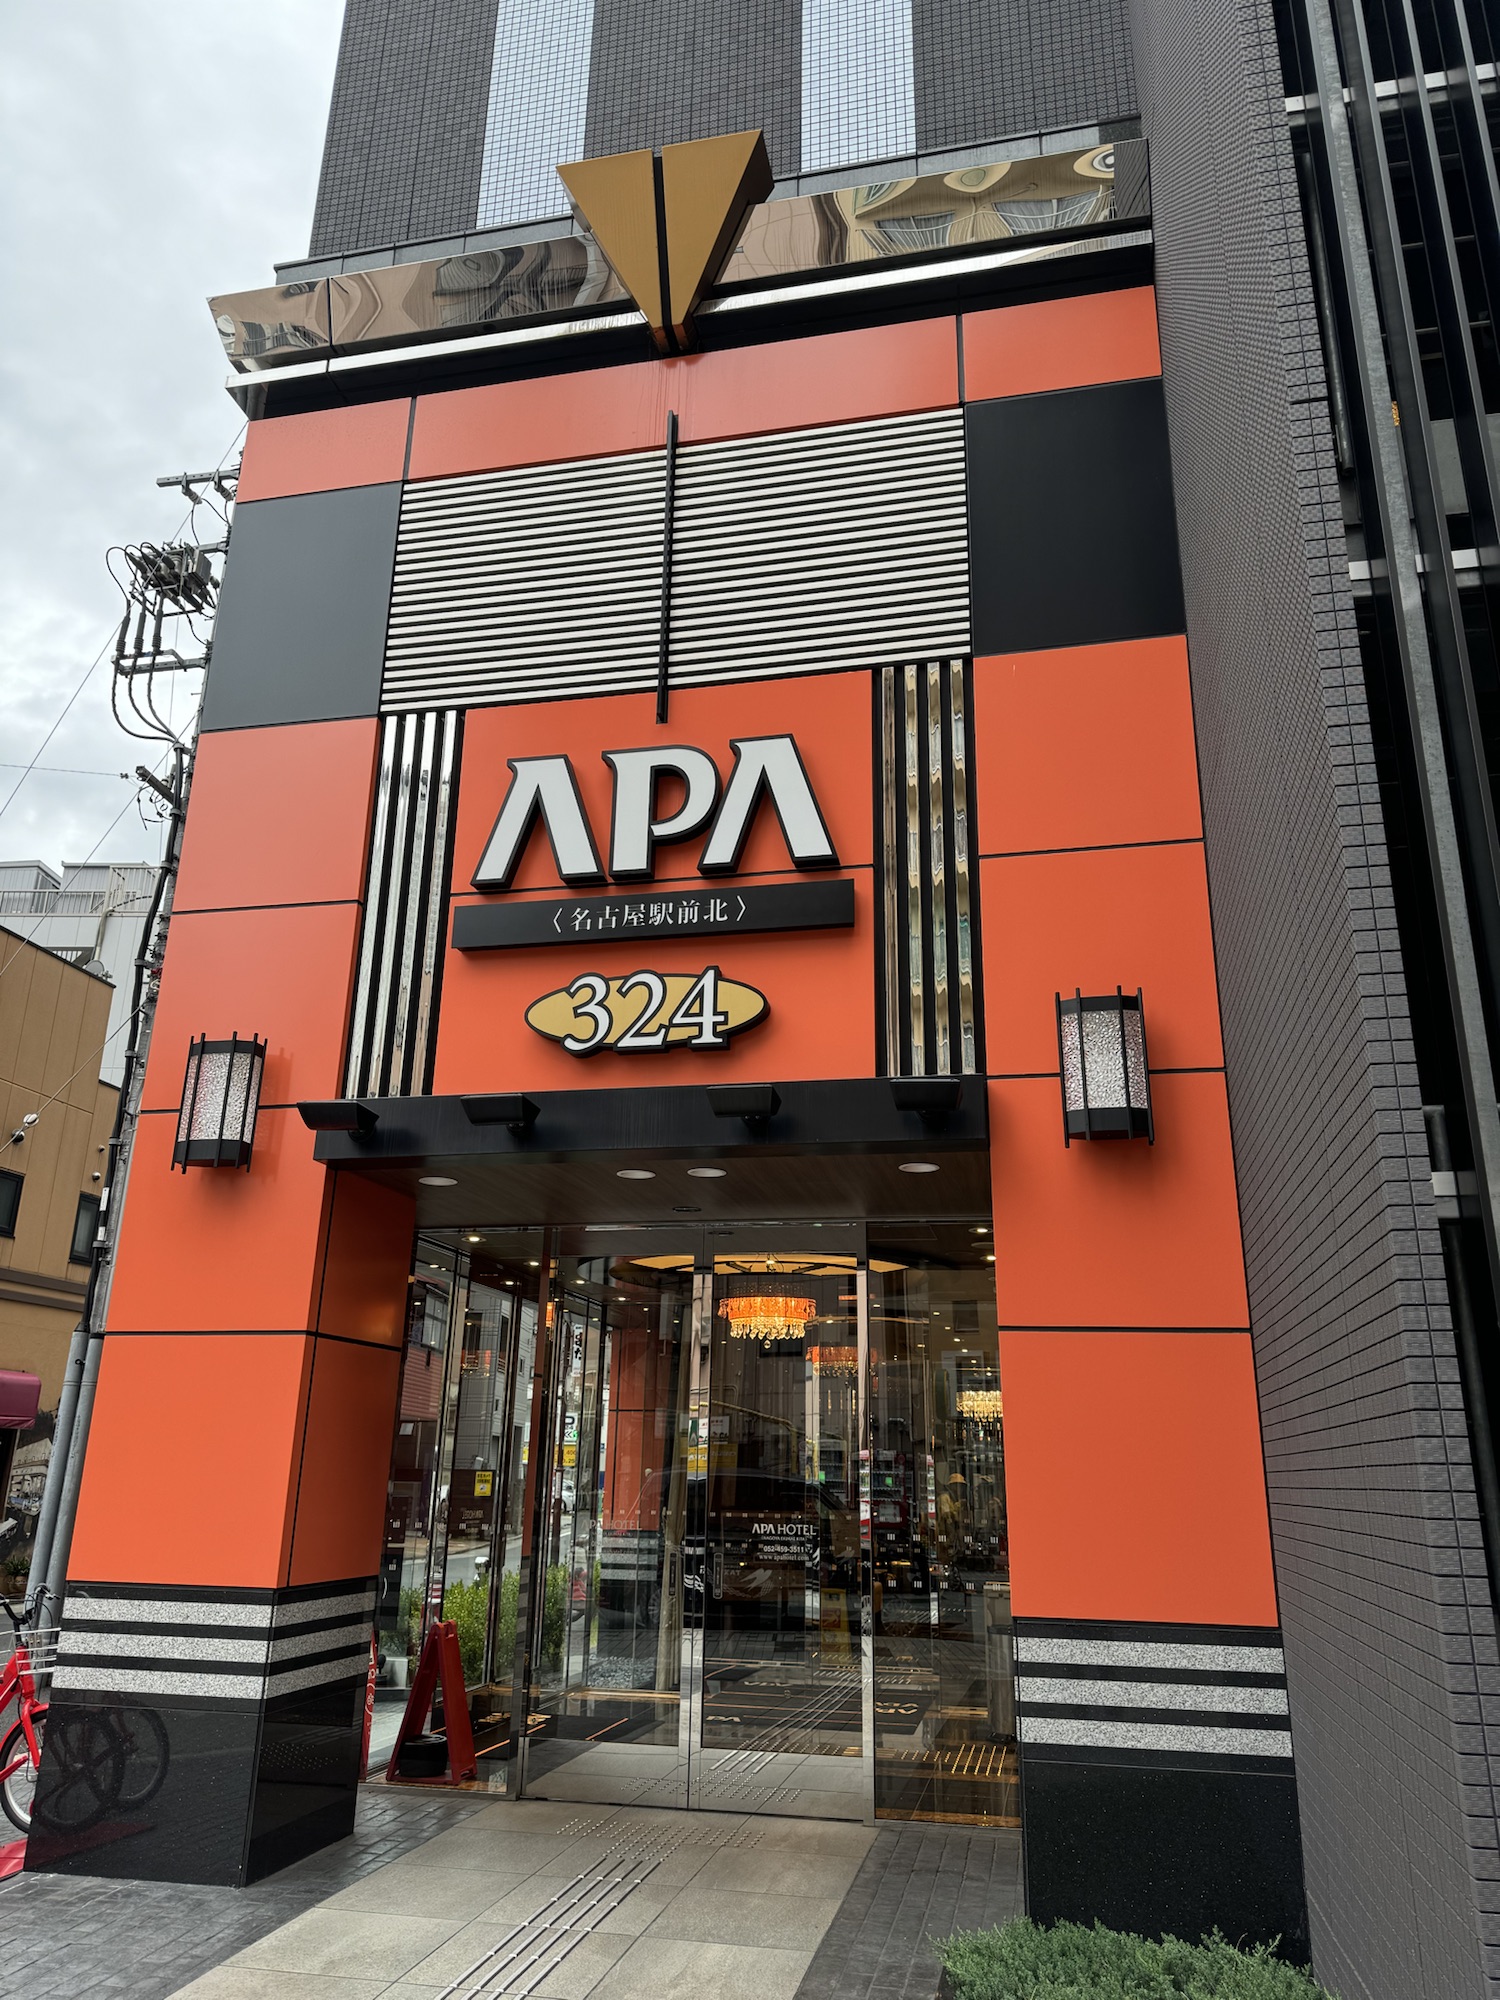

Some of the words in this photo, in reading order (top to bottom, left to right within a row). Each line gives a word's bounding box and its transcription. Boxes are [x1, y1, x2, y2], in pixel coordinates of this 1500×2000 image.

[471, 734, 840, 890] APA
[561, 966, 729, 1057] 324
[605, 1520, 643, 1531] HOTEL
[751, 1523, 775, 1535] APA
[777, 1523, 817, 1536] HOTEL
